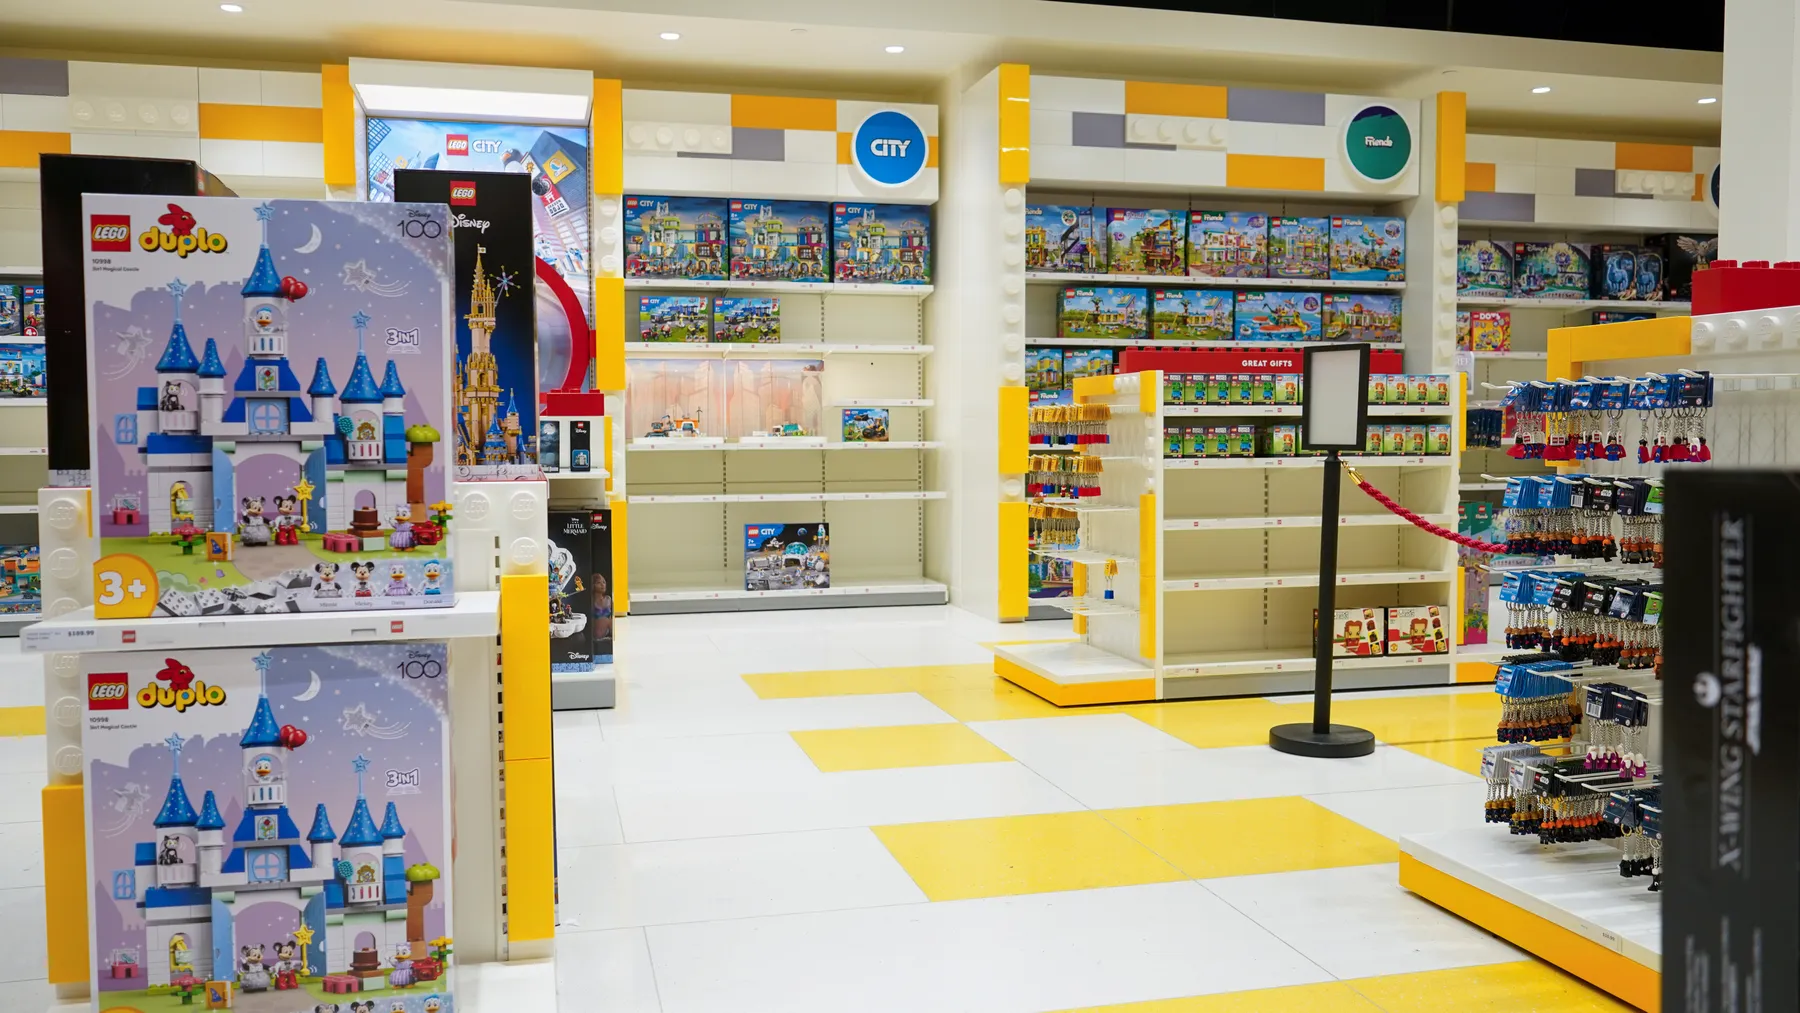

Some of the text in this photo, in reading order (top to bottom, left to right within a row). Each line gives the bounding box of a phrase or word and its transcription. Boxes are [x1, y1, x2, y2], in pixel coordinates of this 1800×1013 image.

[448, 140, 502, 153] LEGO CITY
[1364, 136, 1393, 147] Friends
[870, 138, 911, 158] CITY
[452, 188, 475, 199] LEGO
[405, 208, 432, 220] Disney
[1204, 214, 1223, 222] Friends
[1344, 219, 1363, 227] Friends
[397, 219, 442, 239] 100
[93, 225, 228, 259] LEGO duplo
[1076, 289, 1094, 297] Friends
[1166, 292, 1183, 300] Friends
[1242, 359, 1293, 368] GREAT GIFTS
[1040, 392, 1058, 400] Friends
[760, 528, 776, 536] CITY
[98, 571, 147, 605] 3+
[405, 650, 432, 660] Disney
[567, 652, 590, 661] Disney
[397, 659, 442, 680] 100
[90, 681, 227, 714] LEGO duplo
[1719, 517, 1744, 871] X-WING STARFIGHTER
